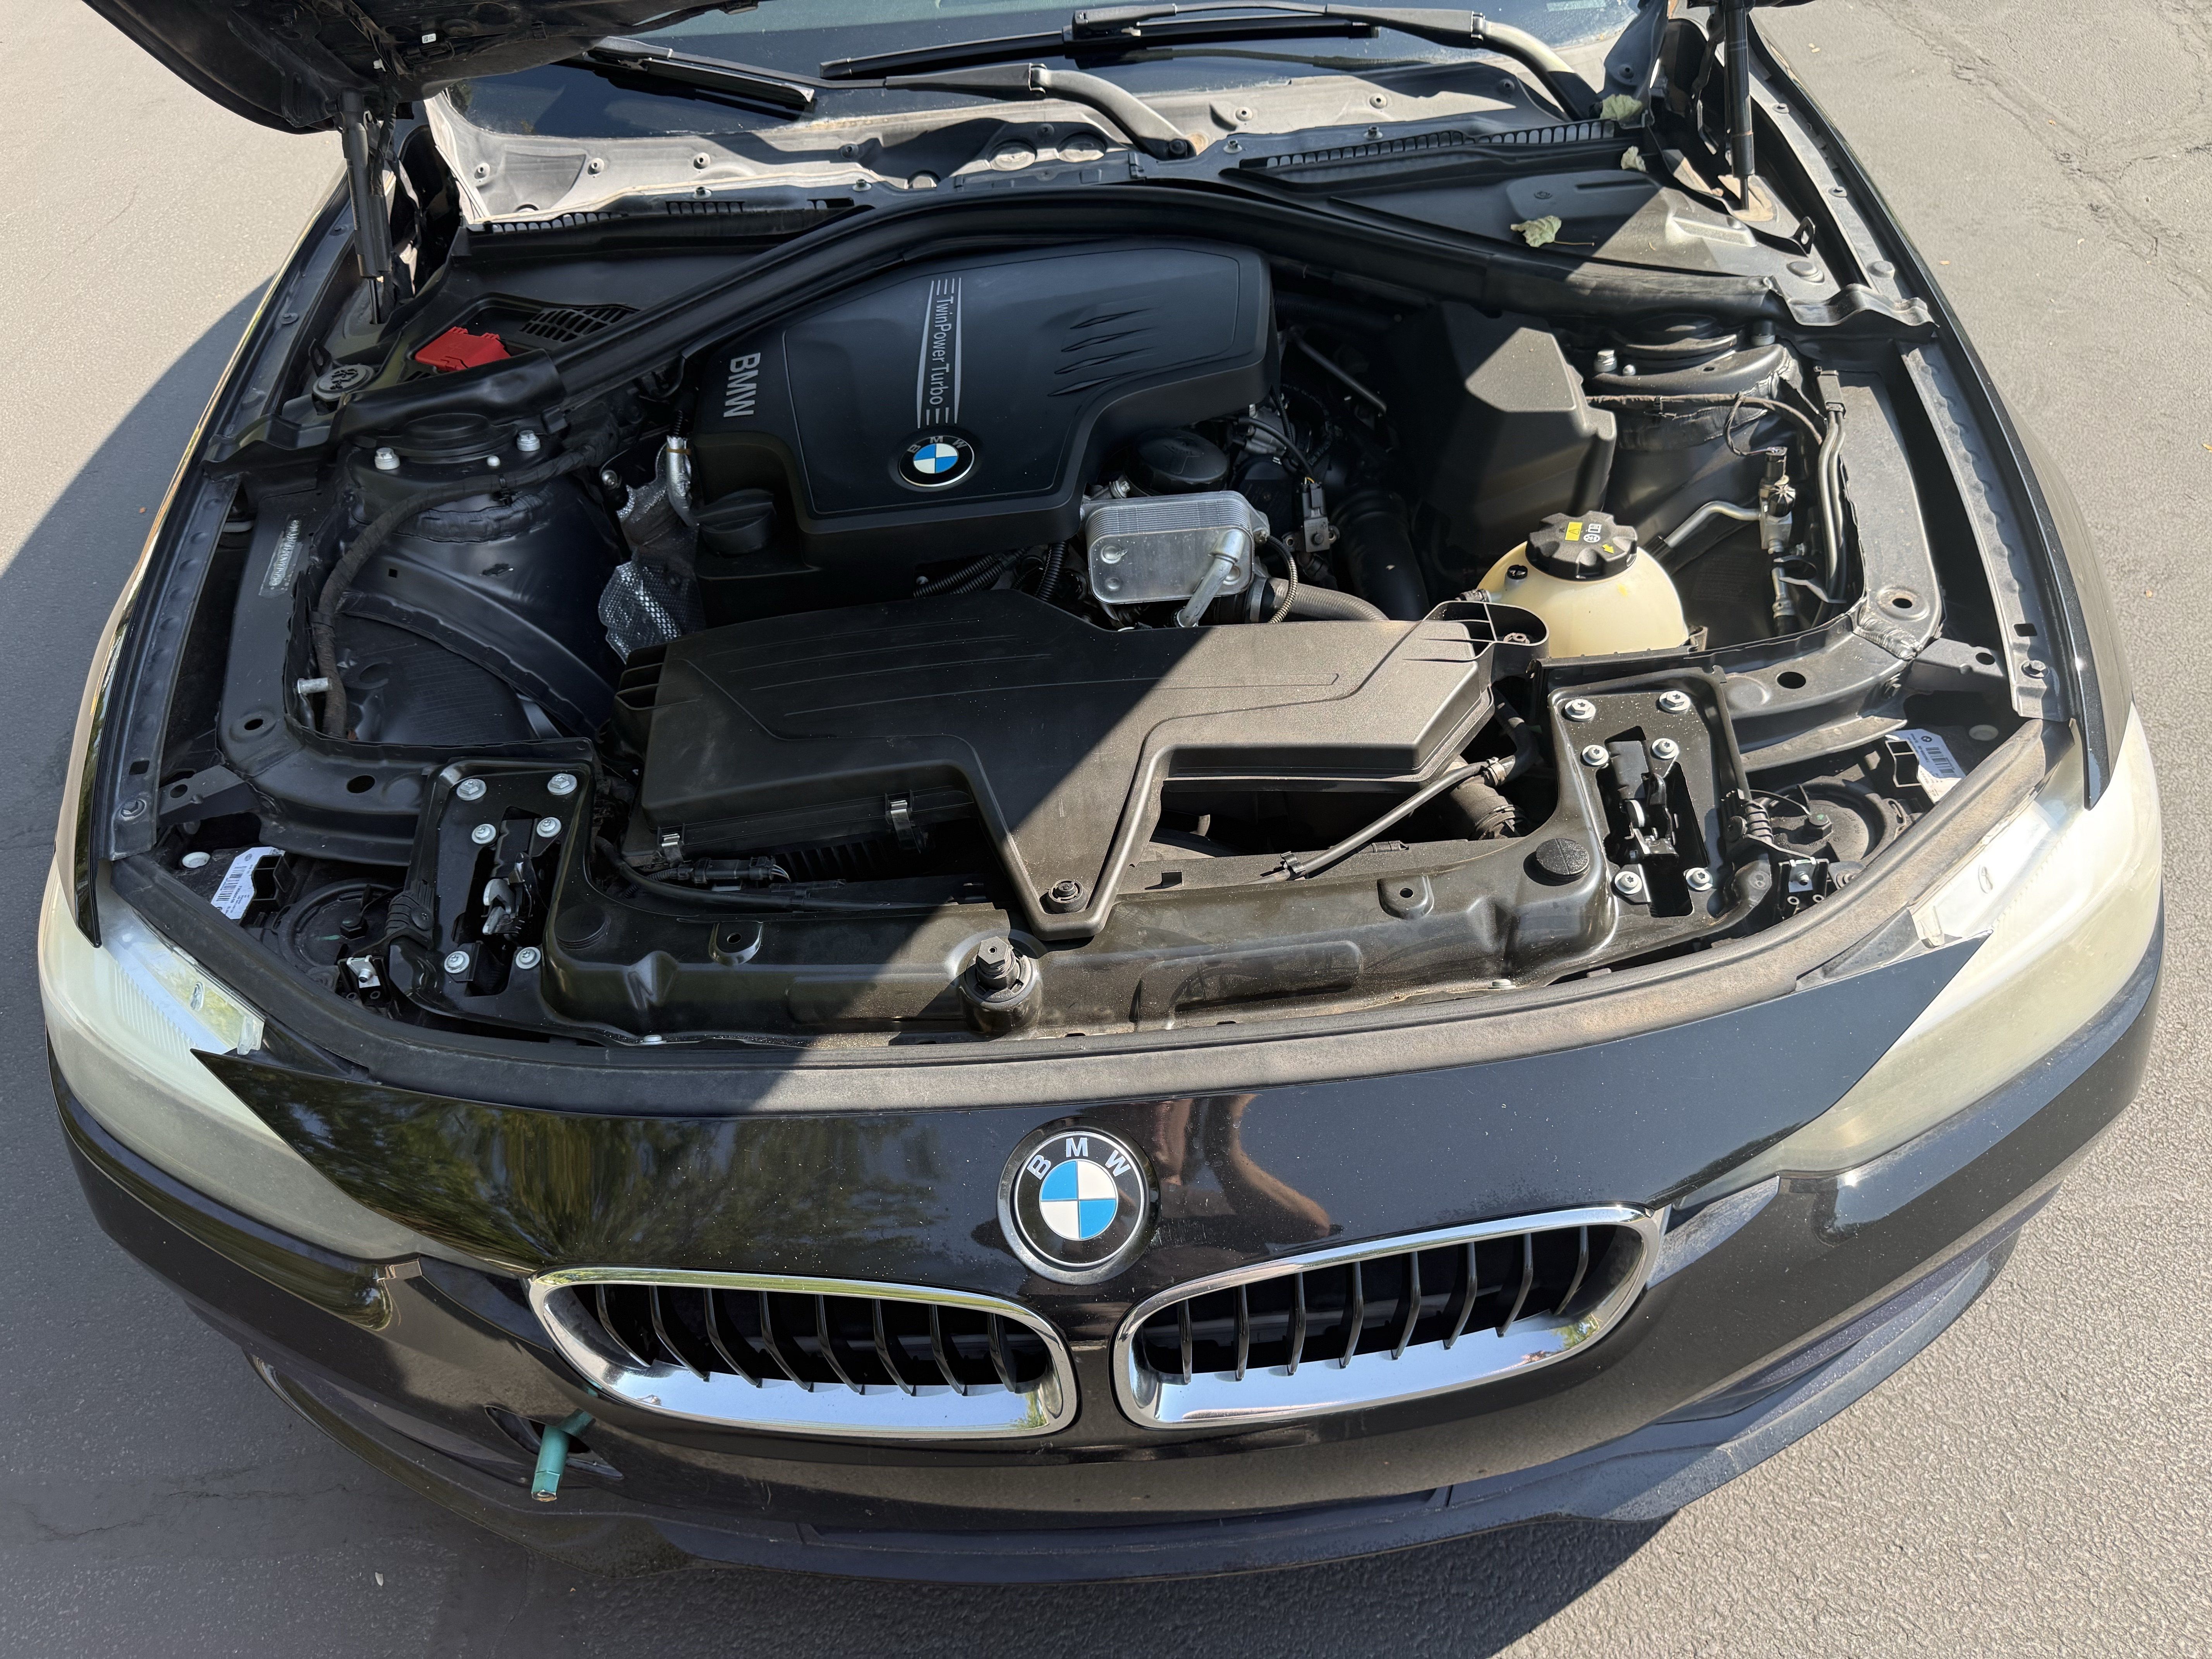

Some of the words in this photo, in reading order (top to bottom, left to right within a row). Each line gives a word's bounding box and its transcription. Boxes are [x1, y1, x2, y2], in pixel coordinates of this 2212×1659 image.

[932, 296, 954, 362] TwinPower
[723, 352, 761, 417] BMW
[929, 363, 950, 405] Turbo
[907, 435, 967, 454] BMW
[1026, 1137, 1131, 1180] BMW
